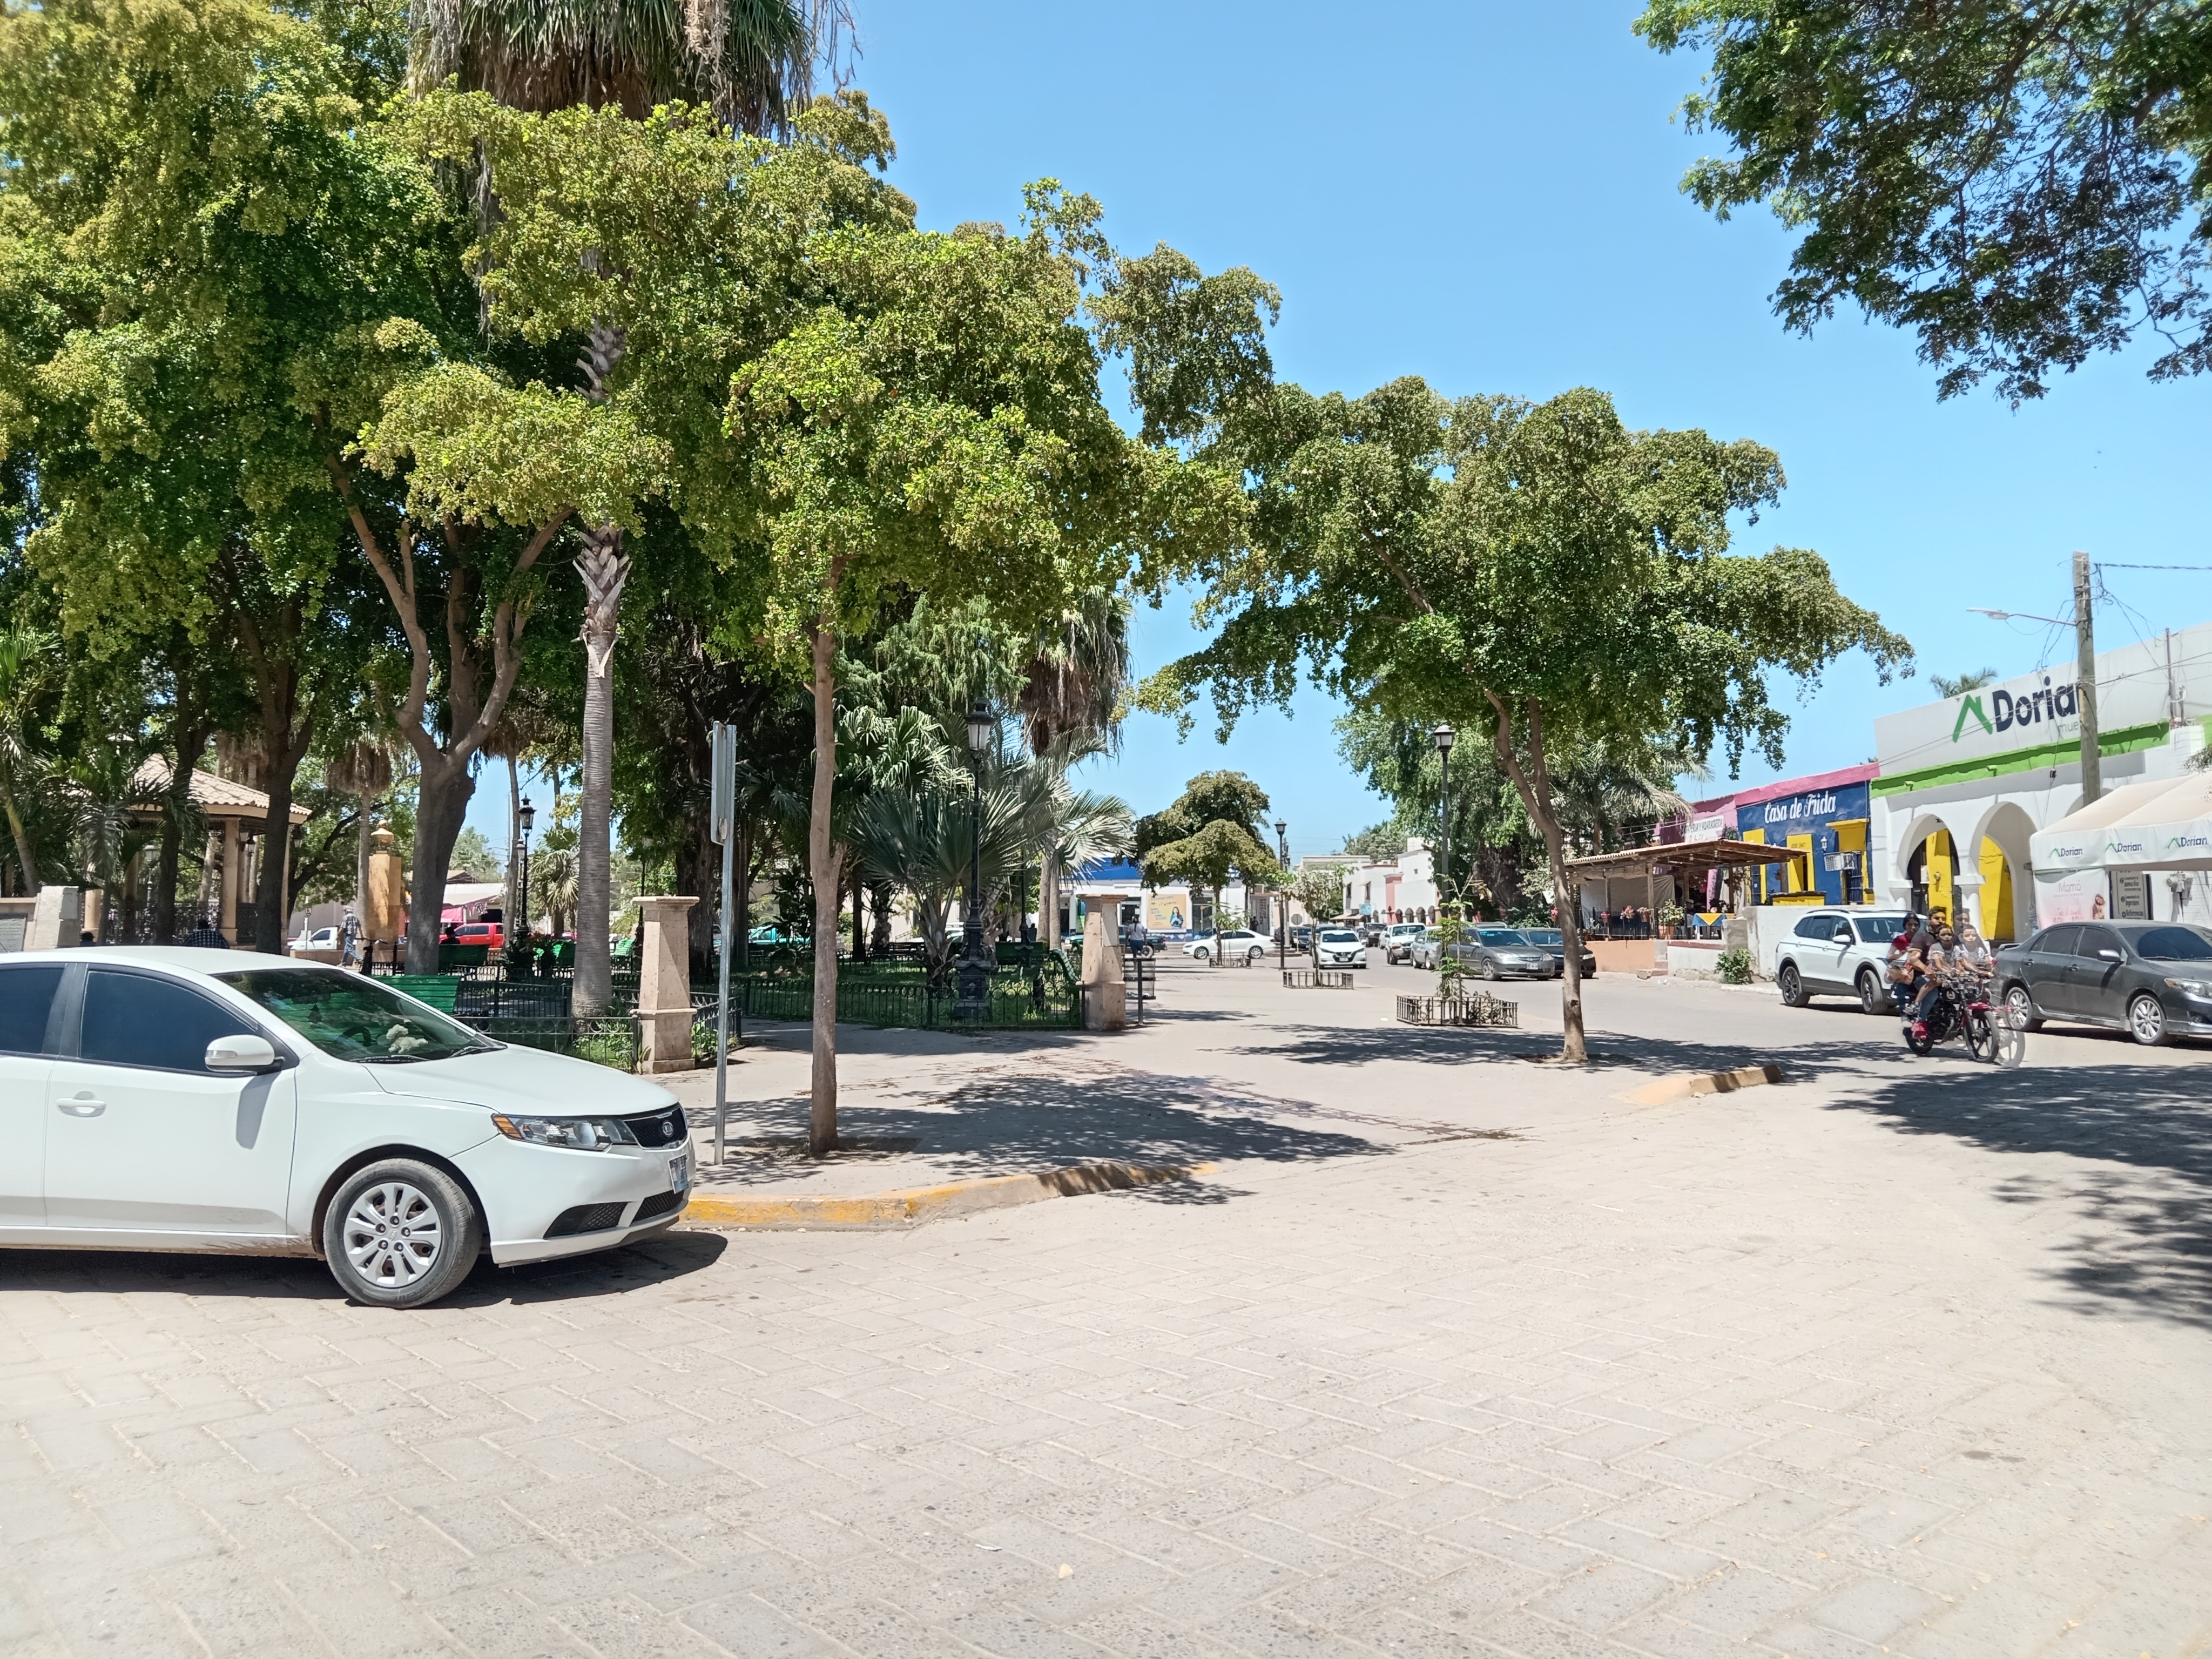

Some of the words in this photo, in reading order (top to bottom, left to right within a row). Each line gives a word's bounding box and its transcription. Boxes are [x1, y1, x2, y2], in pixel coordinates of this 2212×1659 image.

[1764, 802, 1787, 824] Casa
[1790, 797, 1802, 819] de
[1804, 791, 1836, 817] Frida
[2116, 842, 2142, 852] Dorian
[2181, 836, 2208, 847] Dorian
[2061, 847, 2083, 857] Dorian
[2059, 880, 2081, 892] Mamá
